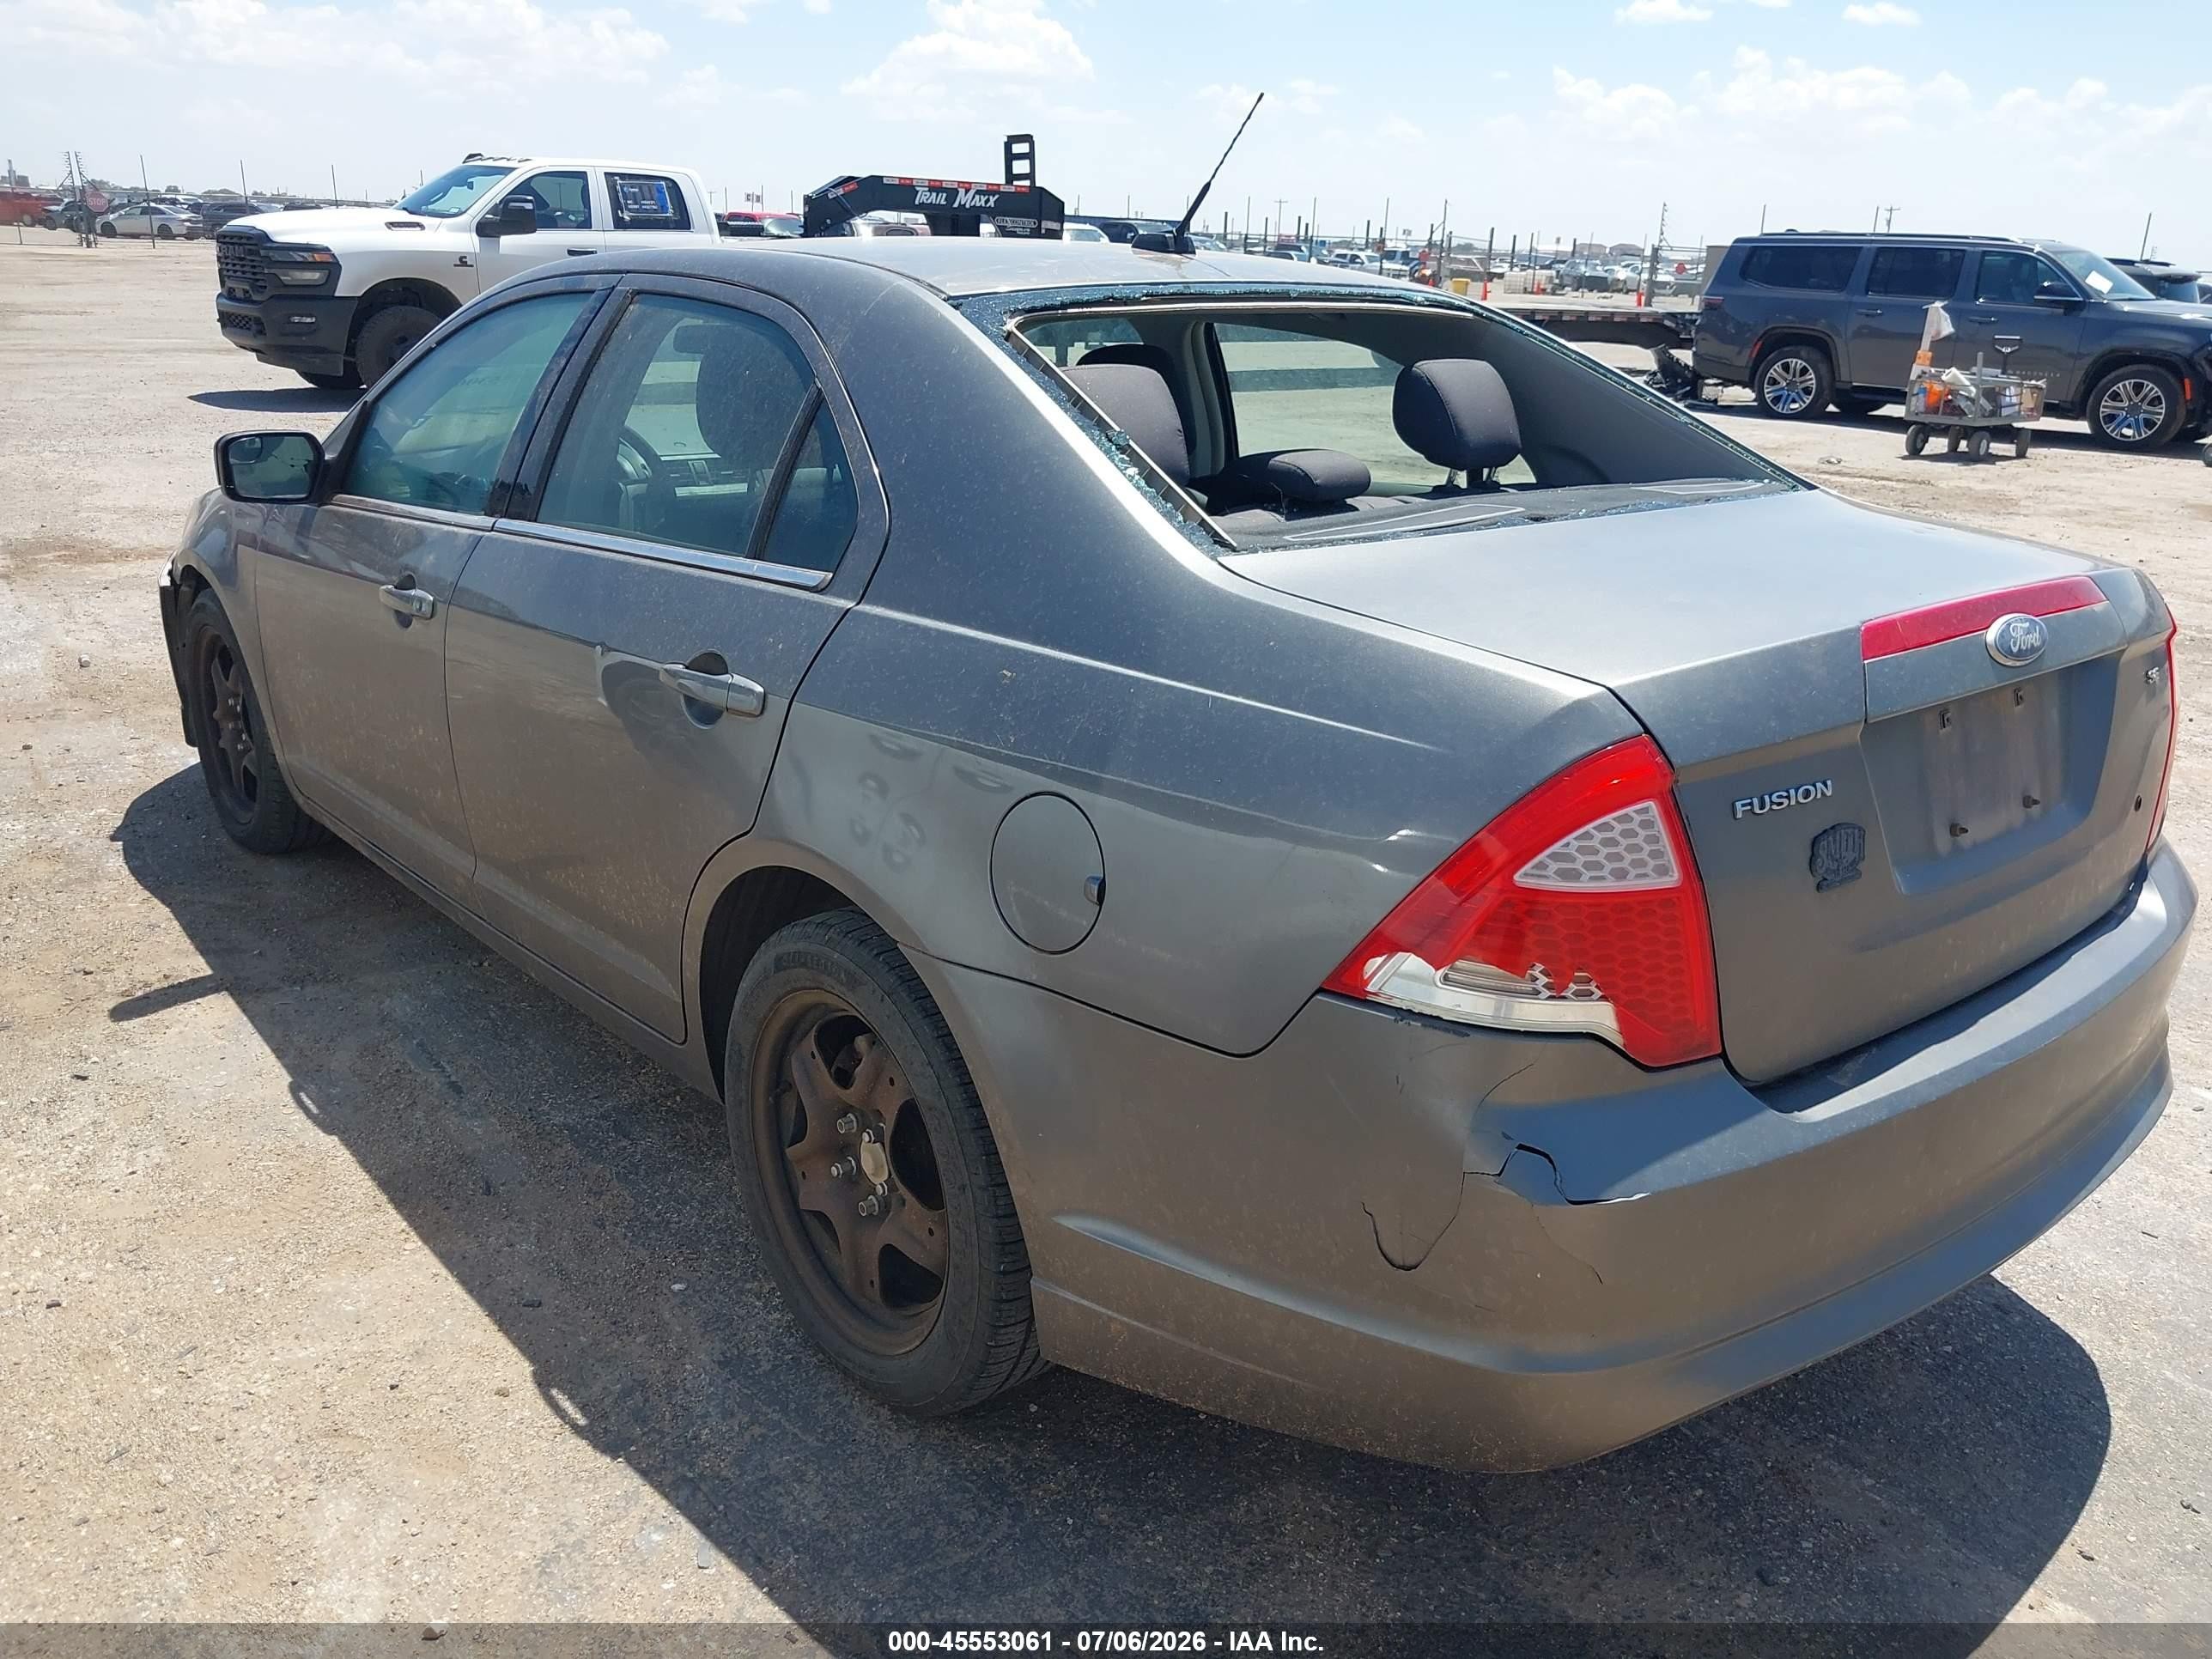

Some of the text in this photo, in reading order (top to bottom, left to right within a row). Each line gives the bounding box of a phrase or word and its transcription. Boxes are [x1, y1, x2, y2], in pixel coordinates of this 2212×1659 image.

[88, 198, 106, 206] STOP
[952, 187, 1000, 209] MAXX
[220, 245, 245, 257] RAM
[2008, 621, 2041, 653] Ford
[1735, 779, 1833, 819] FUSION
